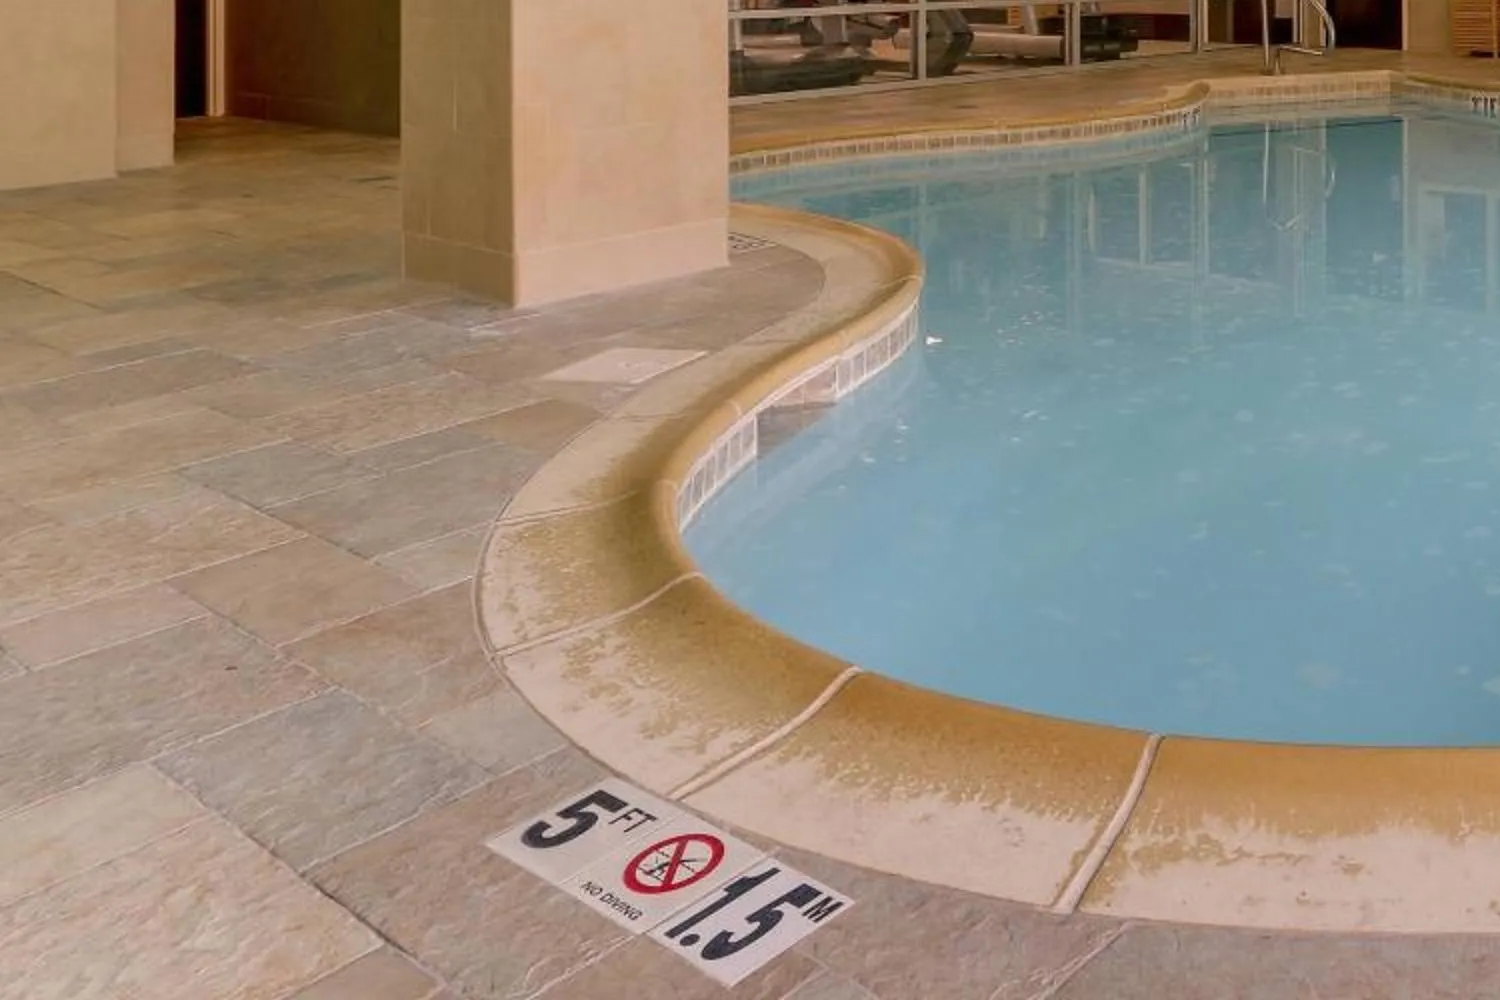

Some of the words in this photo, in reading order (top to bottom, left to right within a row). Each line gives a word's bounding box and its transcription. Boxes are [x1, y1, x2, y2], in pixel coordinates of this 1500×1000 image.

[521, 789, 629, 849] 5
[607, 807, 658, 833] FT
[580, 881, 604, 897] NO
[599, 892, 643, 921] DIVING
[664, 867, 824, 961] 1.5
[801, 896, 844, 923] M
